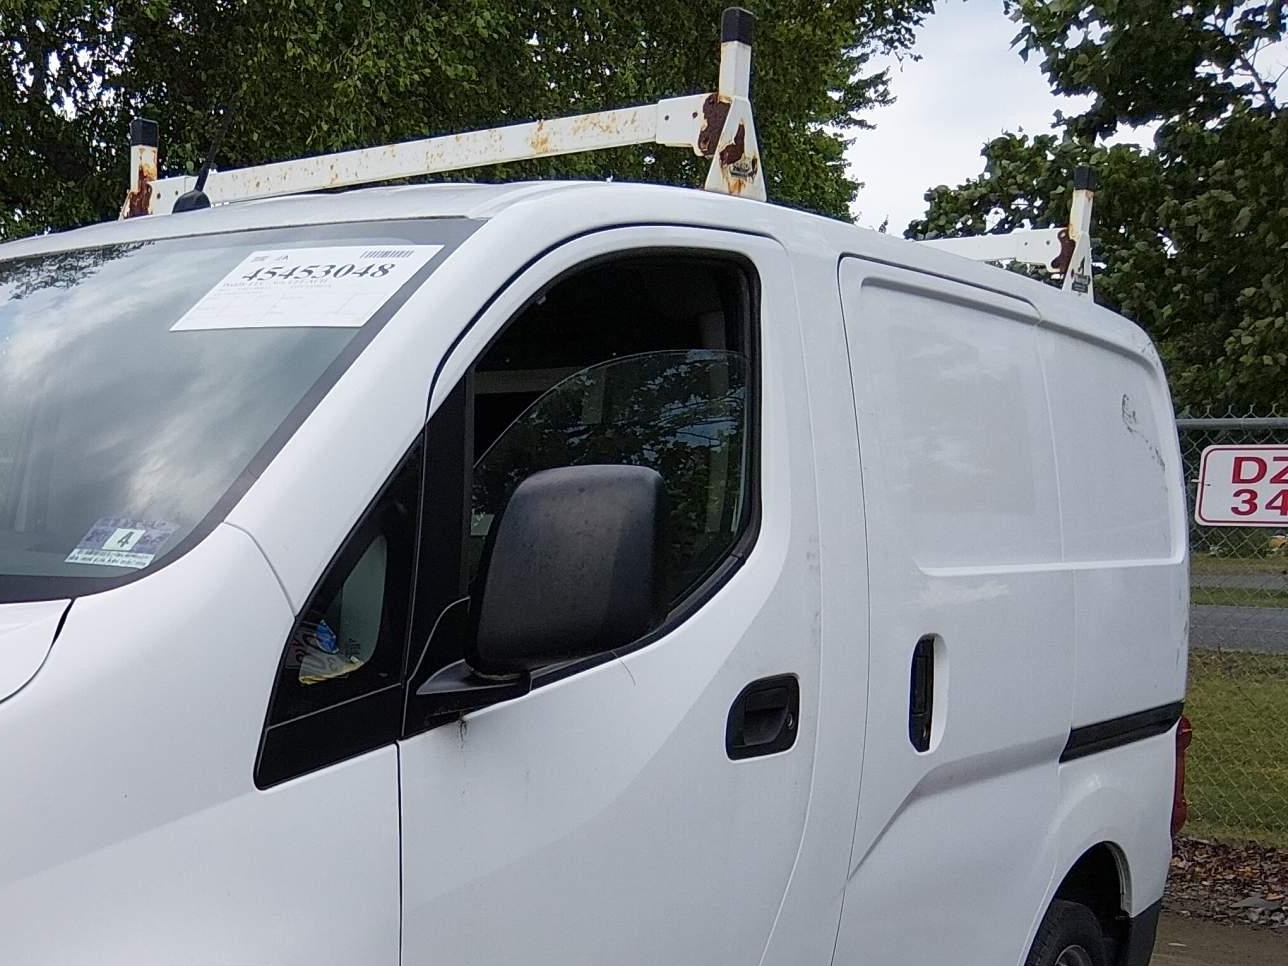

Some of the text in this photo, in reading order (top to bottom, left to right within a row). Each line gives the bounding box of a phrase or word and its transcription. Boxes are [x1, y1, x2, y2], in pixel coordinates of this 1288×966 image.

[242, 262, 396, 281] 45453048
[1230, 488, 1288, 516] 34
[116, 530, 136, 548] 4
